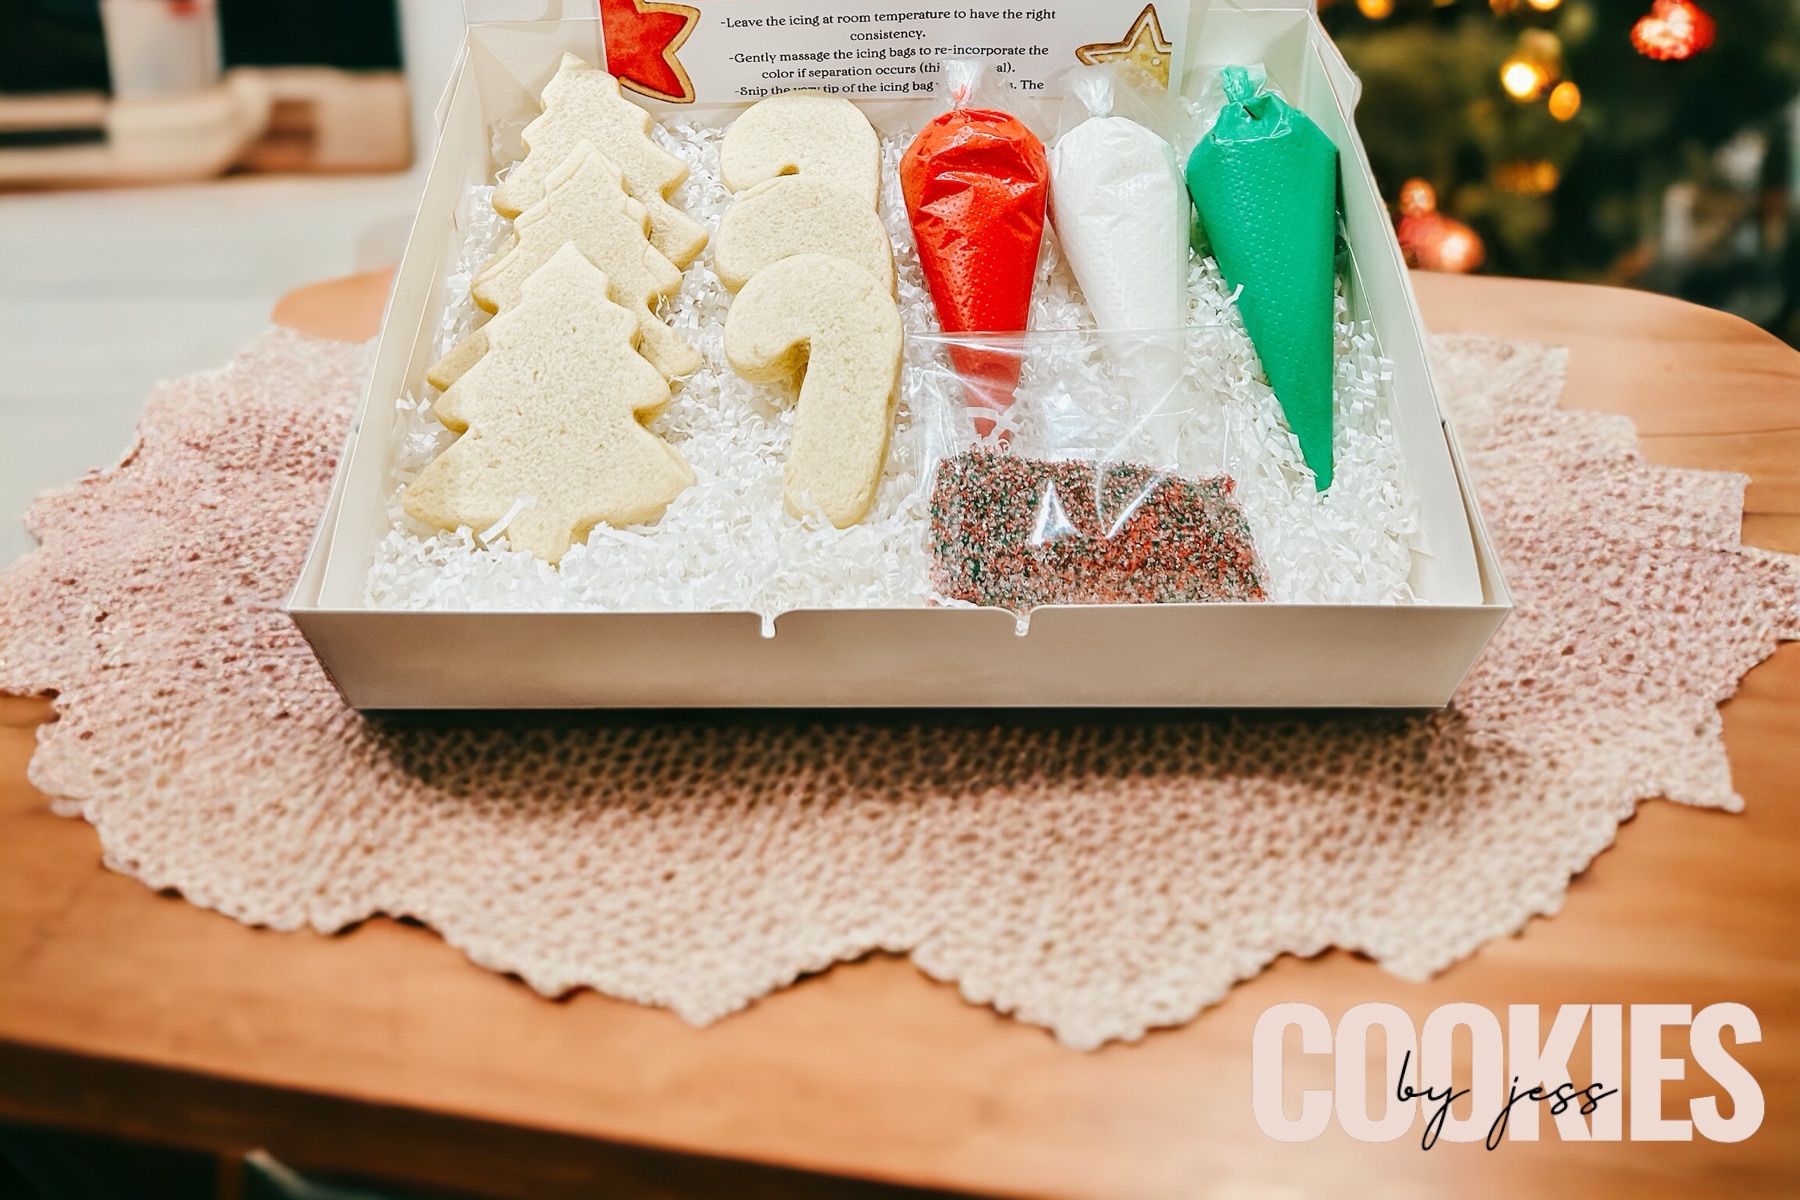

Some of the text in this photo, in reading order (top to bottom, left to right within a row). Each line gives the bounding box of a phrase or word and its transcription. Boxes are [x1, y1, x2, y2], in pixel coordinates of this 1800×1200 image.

[720, 8, 1057, 29] -Leave the icing at room temperature to have the right
[849, 29, 926, 42] consistency.
[728, 44, 1049, 65] -Gently massage the icing bags to re-incorporate the
[761, 68, 795, 80] color
[797, 67, 808, 78] if
[808, 65, 873, 80] separation
[874, 65, 917, 76] occurs
[919, 61, 941, 75] (thi
[734, 85, 769, 98] -Snip
[770, 85, 791, 96] the
[822, 83, 840, 95] tip
[841, 83, 857, 94] of
[857, 82, 877, 93] the
[879, 81, 910, 94] icing
[911, 80, 934, 93] bag
[1019, 79, 1045, 90] The
